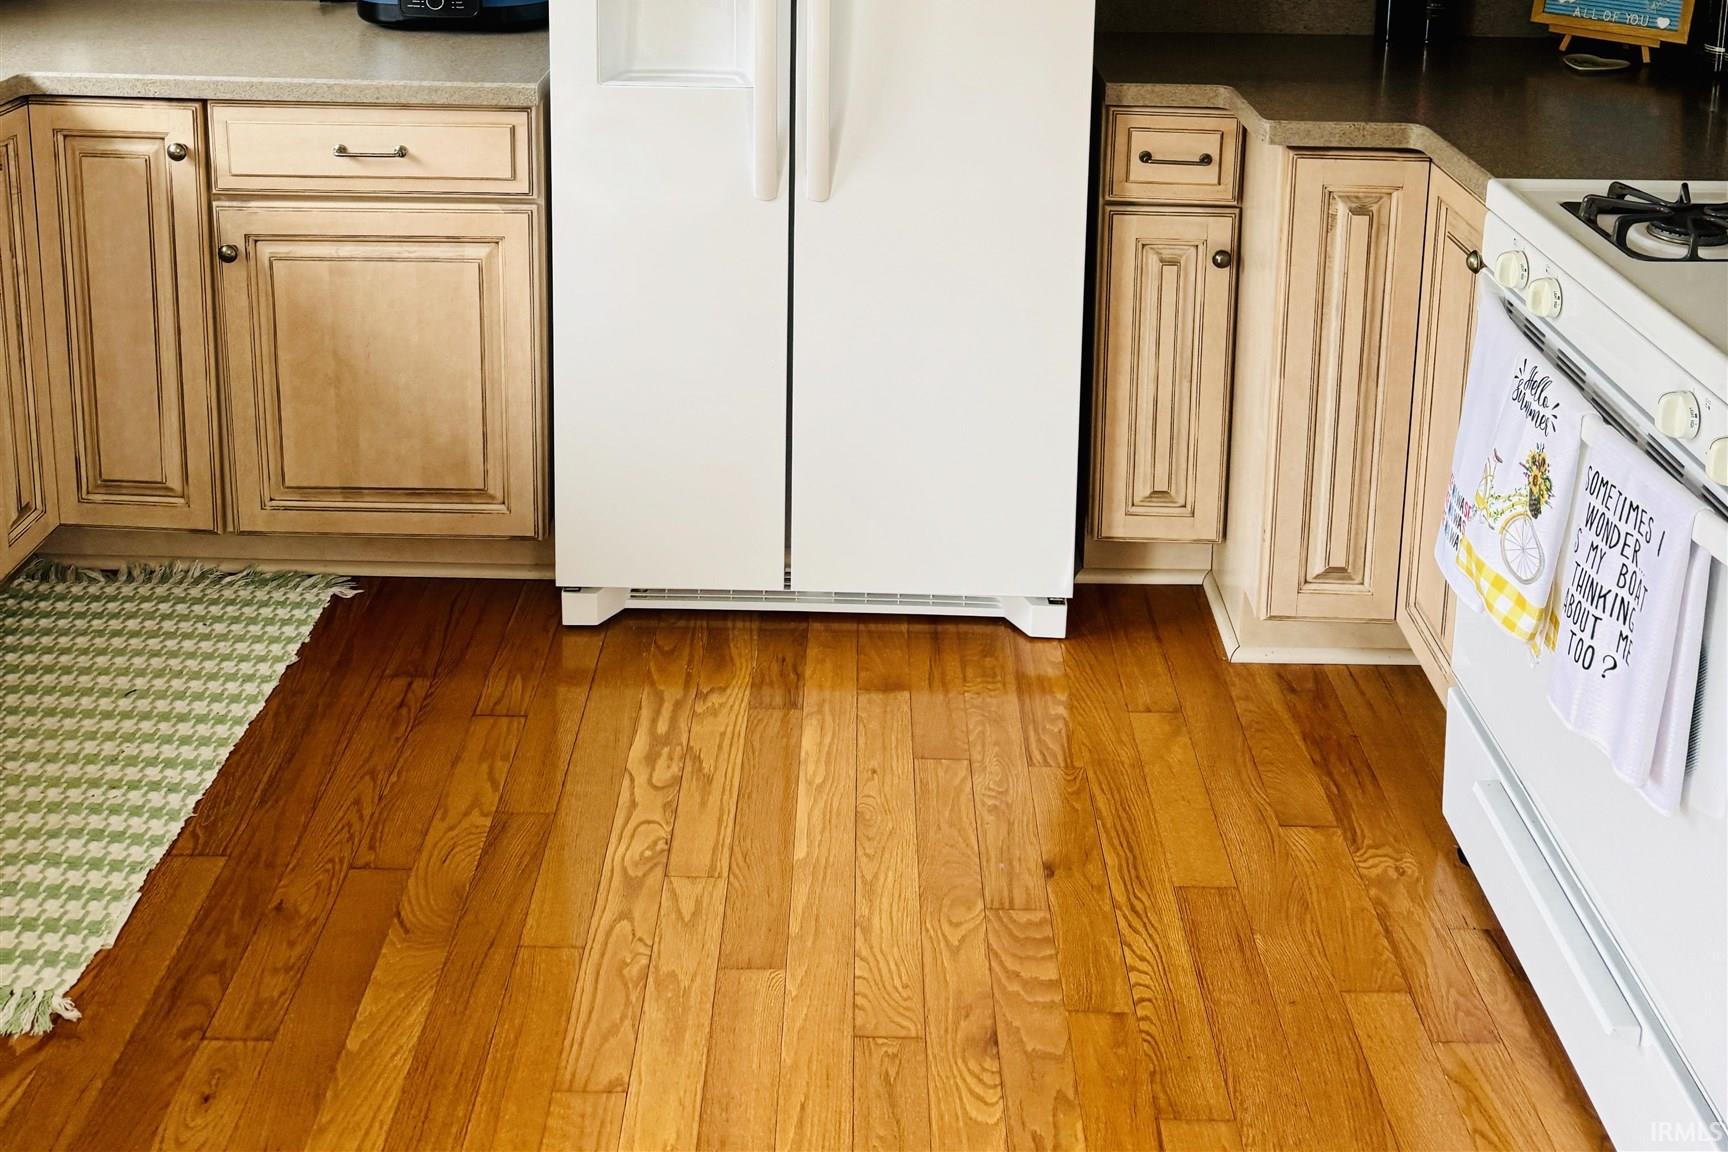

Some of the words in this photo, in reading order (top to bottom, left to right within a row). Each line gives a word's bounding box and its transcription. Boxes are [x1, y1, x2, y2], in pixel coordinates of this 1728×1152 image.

[1572, 7, 1597, 20] ALL
[1602, 9, 1620, 22] OF
[1625, 11, 1649, 26] YOU
[1524, 365, 1553, 409] Hello
[1585, 465, 1654, 544] SOMETIMES
[1571, 561, 1636, 633] THINKING
[1585, 540, 1607, 575] MY
[1616, 562, 1648, 613] BOAT
[1563, 587, 1602, 640] ABOUT
[1616, 629, 1633, 667] ME
[1567, 629, 1596, 670] TOO
